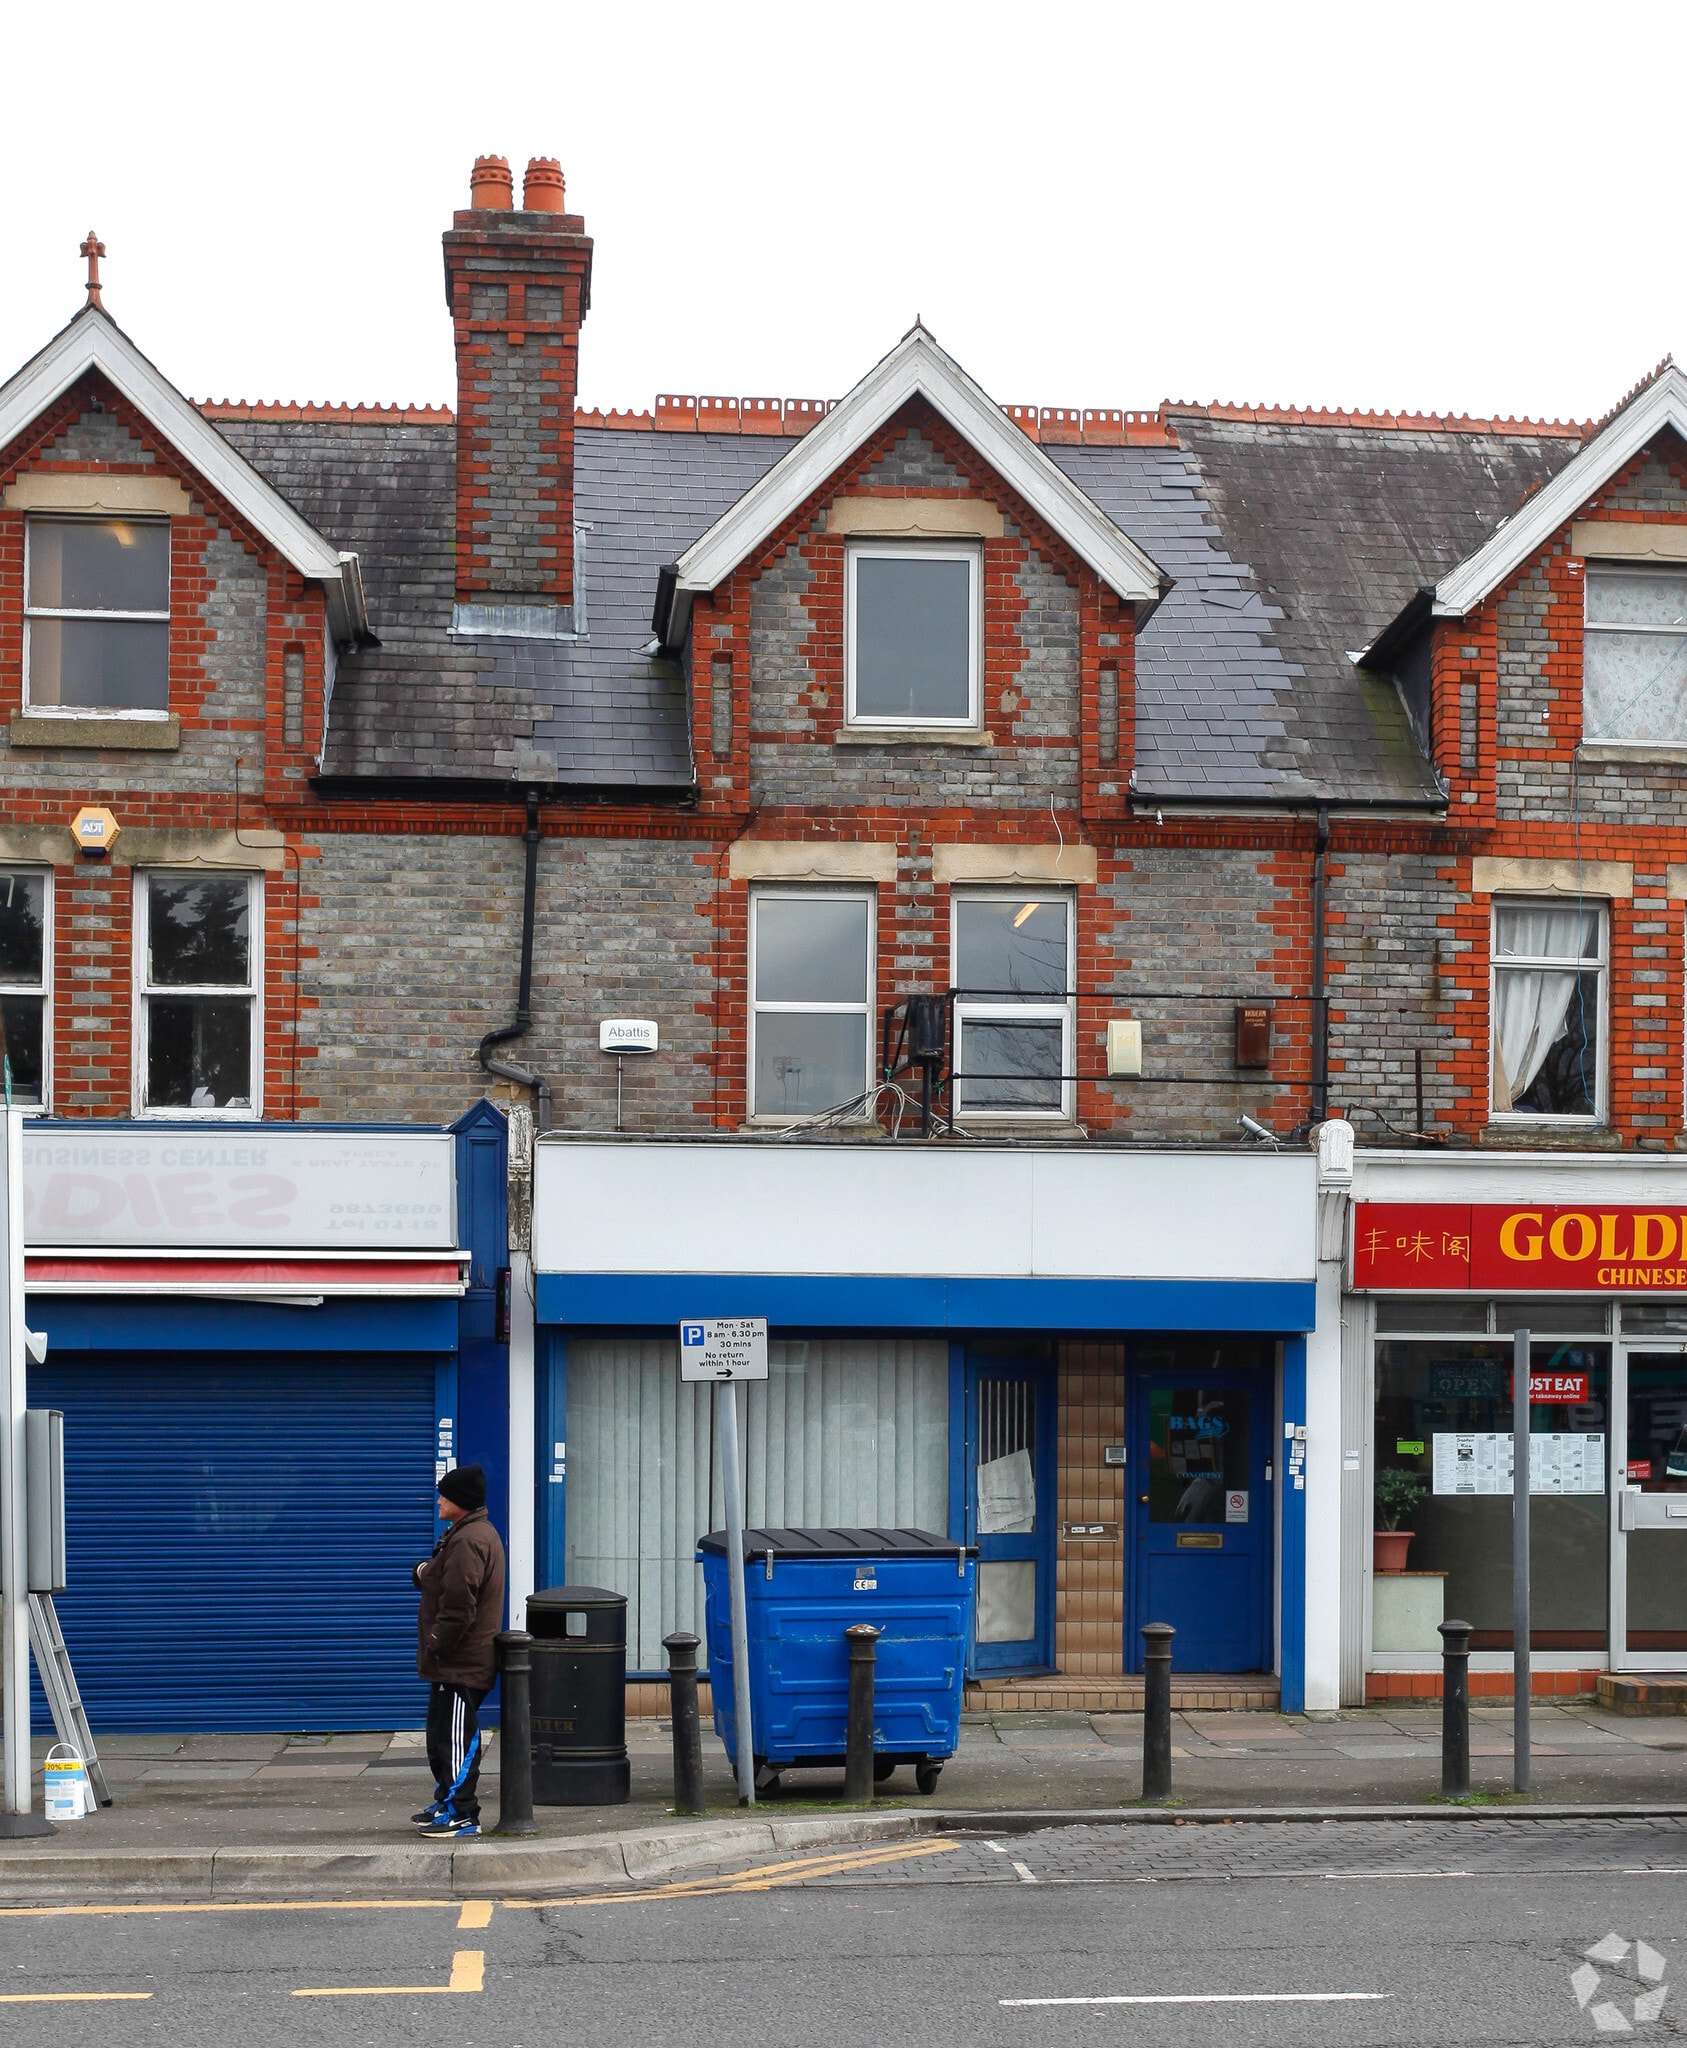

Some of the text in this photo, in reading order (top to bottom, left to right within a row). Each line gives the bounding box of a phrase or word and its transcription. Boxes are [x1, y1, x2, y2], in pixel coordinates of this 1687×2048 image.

[608, 1026, 650, 1038] Abattis
[1500, 1212, 1687, 1262] GOLD
[1597, 1268, 1687, 1286] CHINESE
[688, 1328, 702, 1344] P
[1439, 1378, 1494, 1390] OPEN
[1529, 1378, 1583, 1391] UST EAT
[1170, 1416, 1224, 1430] BAGS
[1176, 1472, 1222, 1480] CONQUEST
